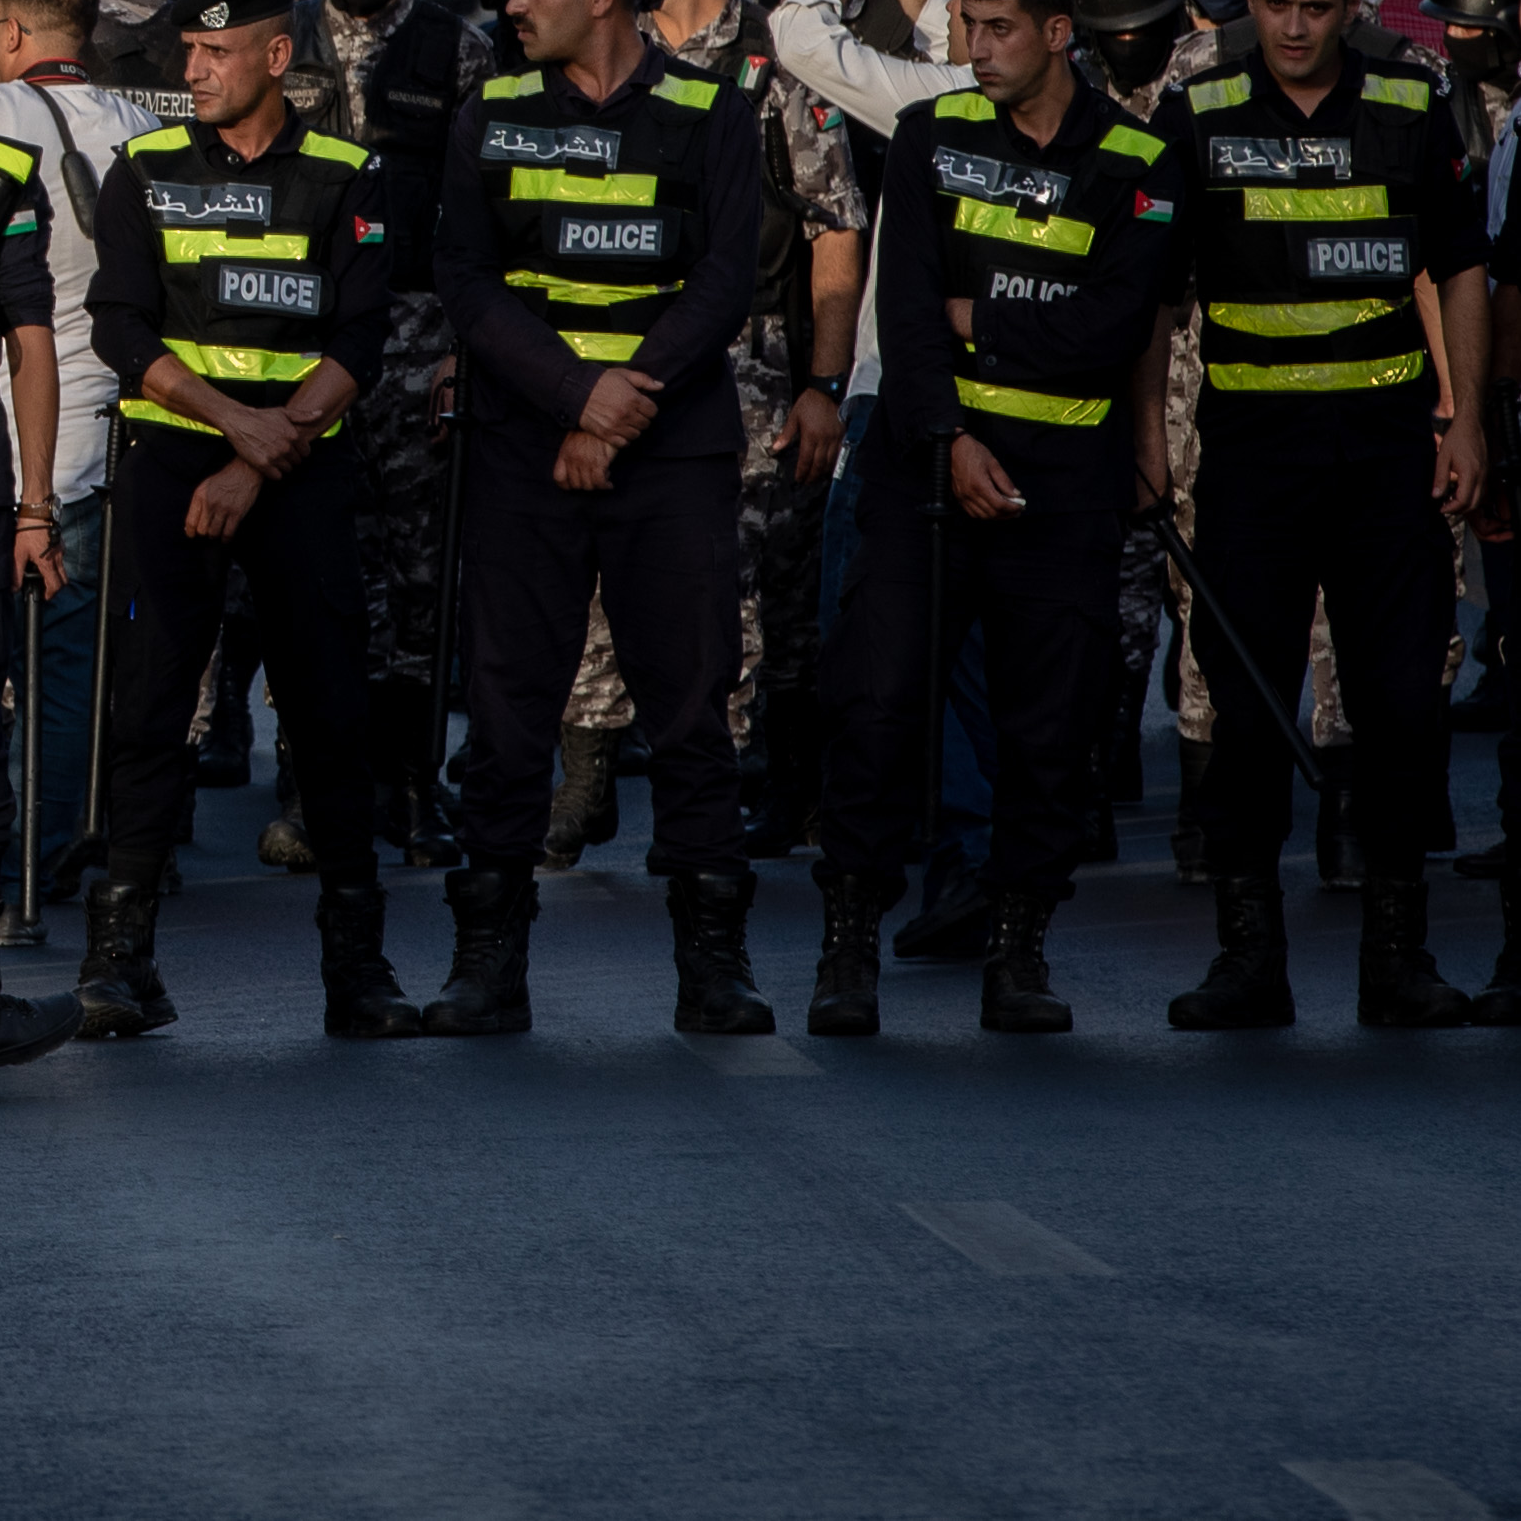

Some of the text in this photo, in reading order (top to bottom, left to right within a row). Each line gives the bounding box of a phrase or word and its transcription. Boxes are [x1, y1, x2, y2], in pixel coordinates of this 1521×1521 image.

[489, 129, 612, 160] الشرطة
[936, 155, 1059, 205] الشرطة
[146, 190, 264, 219] الشرطة
[566, 222, 657, 252] POLICE
[1317, 242, 1405, 272] POLICE
[224, 269, 315, 308] POLICE
